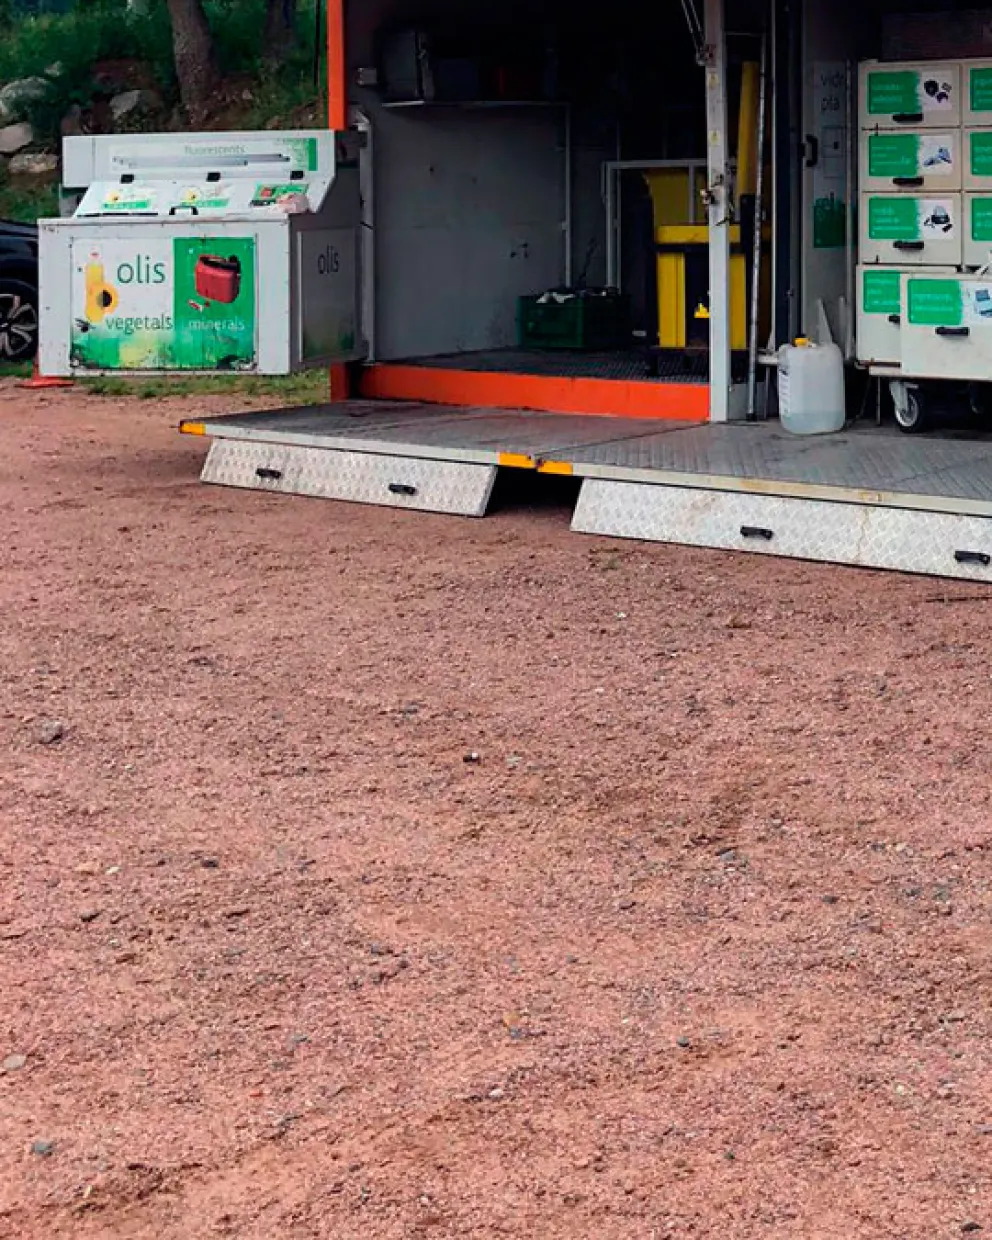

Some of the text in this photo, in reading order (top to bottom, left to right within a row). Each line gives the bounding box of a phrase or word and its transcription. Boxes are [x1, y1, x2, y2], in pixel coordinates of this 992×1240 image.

[117, 254, 166, 284] olis
[317, 245, 340, 275] olis
[105, 313, 174, 334] vegetals
[189, 316, 245, 331] minerals
